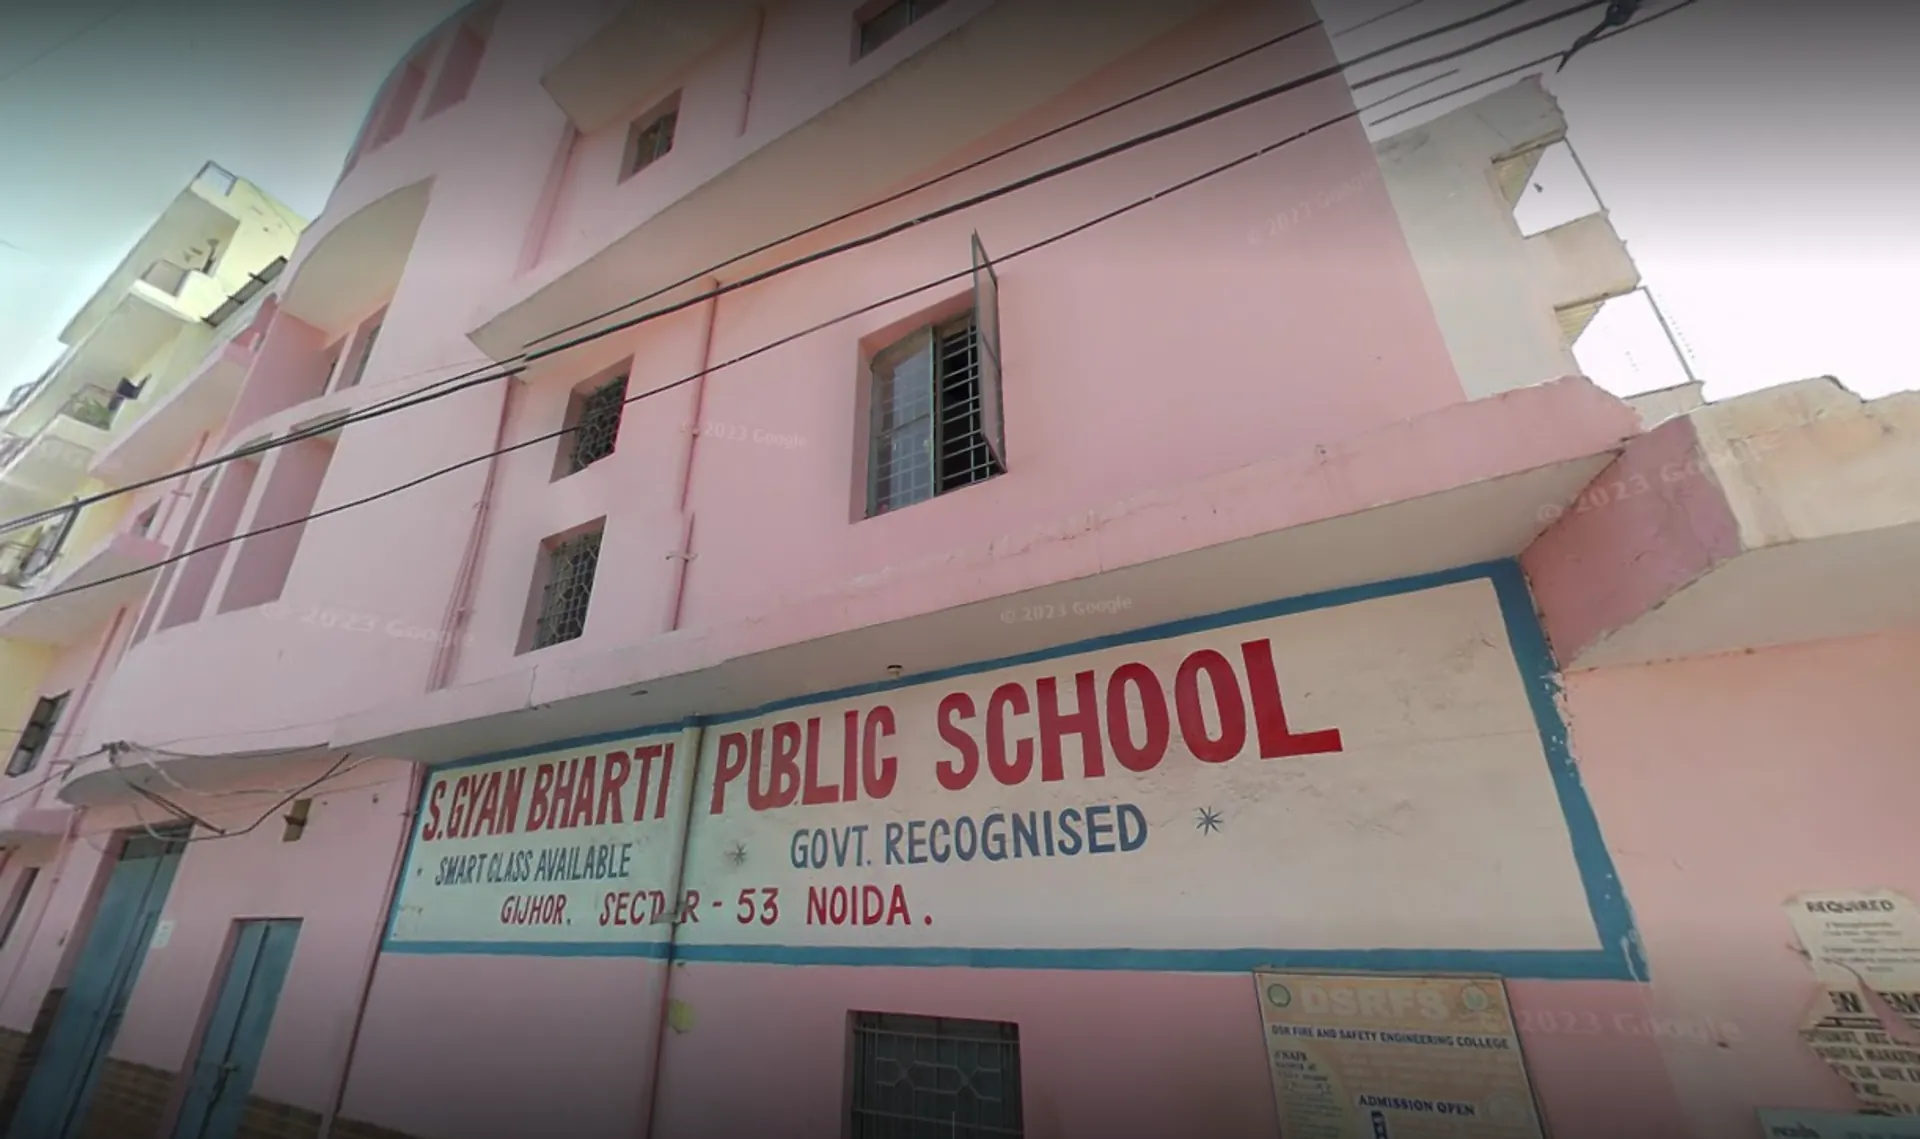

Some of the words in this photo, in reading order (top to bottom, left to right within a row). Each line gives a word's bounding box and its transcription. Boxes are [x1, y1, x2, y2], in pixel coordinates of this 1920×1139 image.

[526, 742, 675, 832] BHARTI
[711, 705, 898, 815] PUBLIC
[936, 638, 1344, 791] SCHOOL
[885, 803, 1148, 866] RECOGNISED
[435, 853, 487, 886] SMART
[487, 850, 534, 883] CLASS
[534, 843, 632, 881] AVAILABLE
[737, 888, 779, 926] 53
[1806, 900, 1895, 913] REQUIRED
[1301, 986, 1450, 1020] DSRFS
[1293, 1026, 1314, 1037] FIRE
[1317, 1028, 1337, 1039] AND
[1339, 1029, 1377, 1041] SAFETY
[1380, 1032, 1454, 1046] ENGINEERING
[1456, 1036, 1509, 1049] COLLEGE
[1359, 1095, 1433, 1112] ADMISSION
[1437, 1102, 1475, 1116] OPEN
